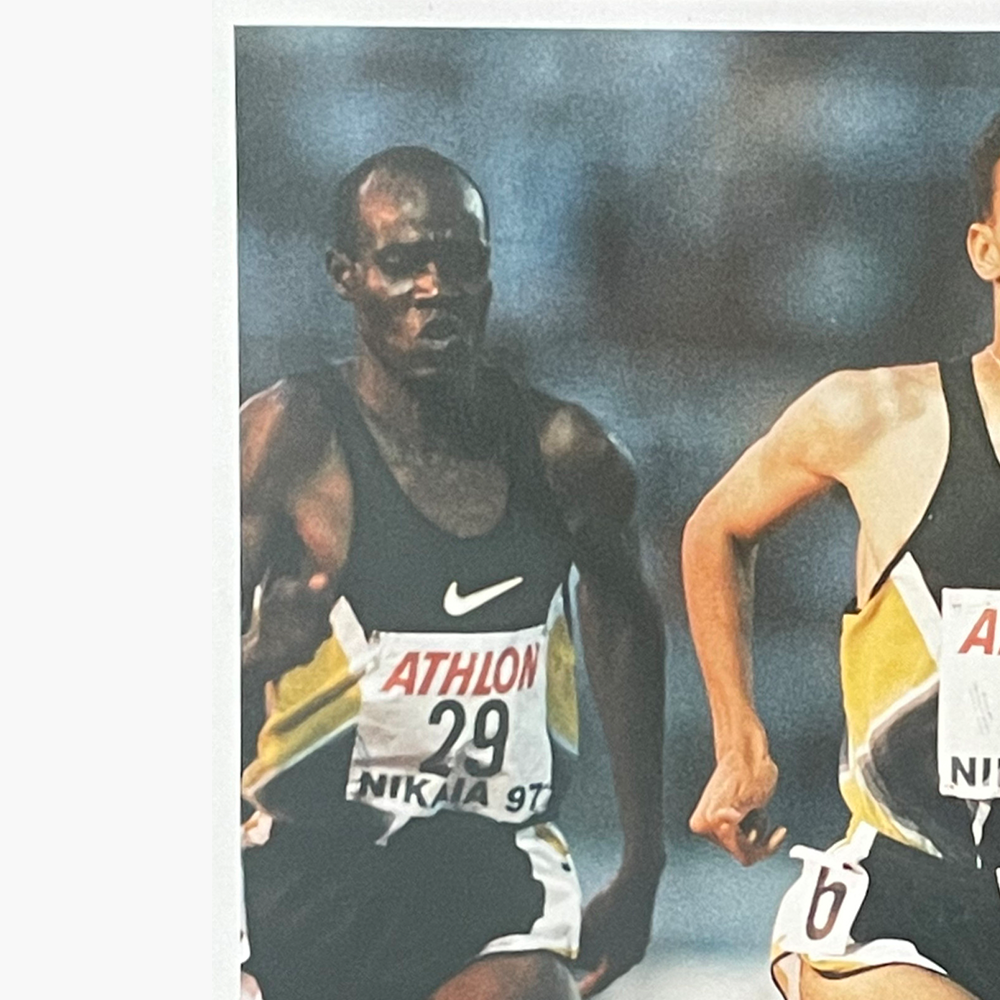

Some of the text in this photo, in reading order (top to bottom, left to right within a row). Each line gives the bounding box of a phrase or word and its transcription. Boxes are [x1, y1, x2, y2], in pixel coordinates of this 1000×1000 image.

[381, 642, 540, 696] ATHLON
[419, 698, 510, 777] 29
[358, 771, 549, 812] NIKAIA 97
